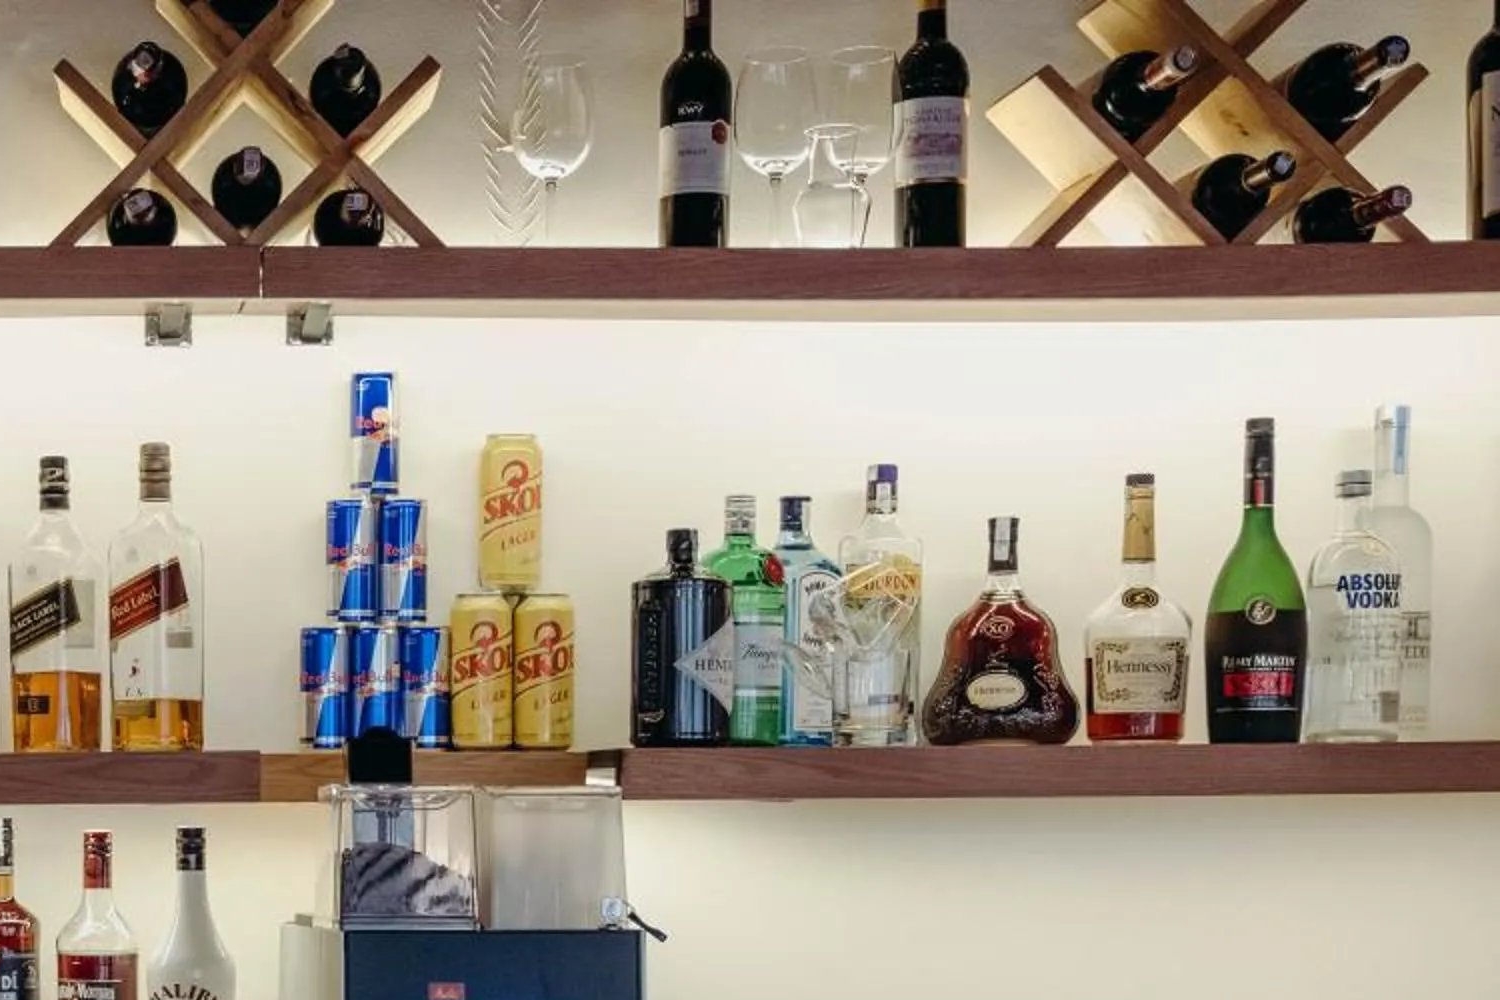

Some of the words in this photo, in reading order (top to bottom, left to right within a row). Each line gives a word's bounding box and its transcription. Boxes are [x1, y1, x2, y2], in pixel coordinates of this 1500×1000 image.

[1336, 573, 1402, 592] ABSOLU
[1106, 658, 1174, 676] Hennessy
[1253, 652, 1297, 668] MARTIN
